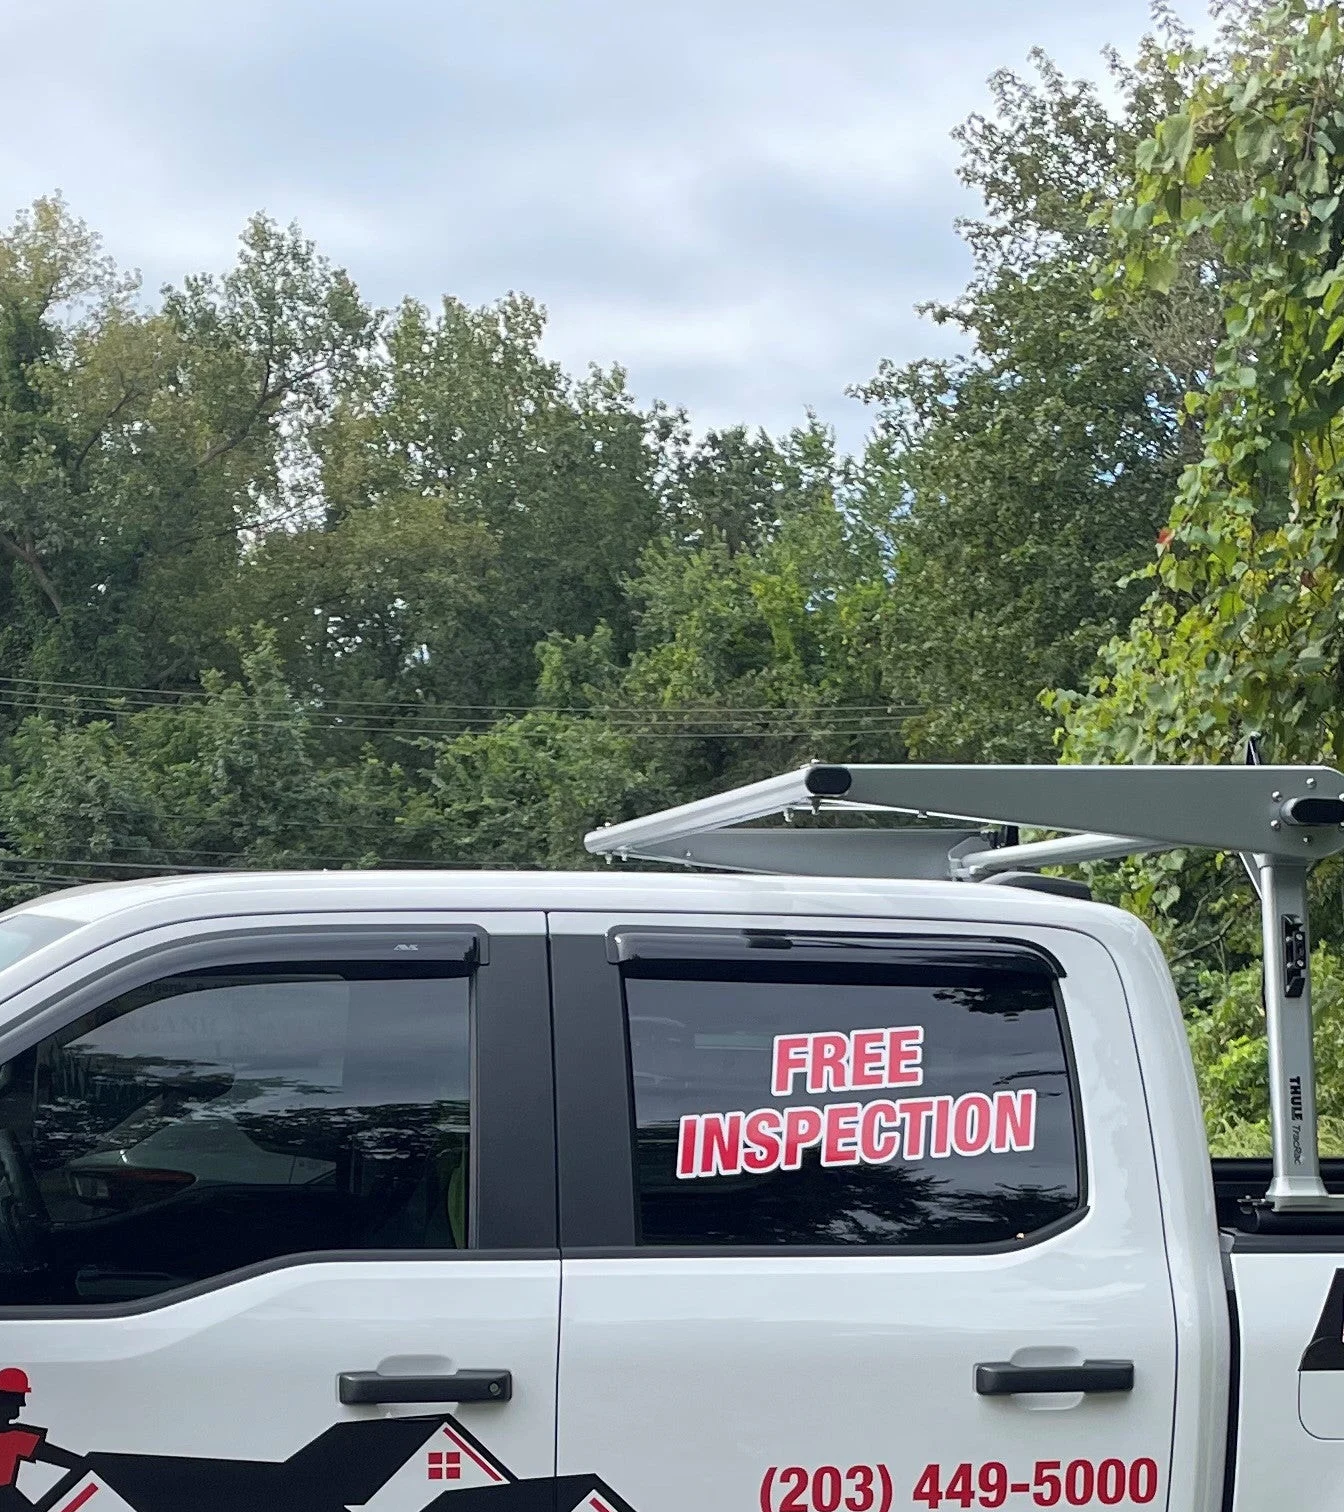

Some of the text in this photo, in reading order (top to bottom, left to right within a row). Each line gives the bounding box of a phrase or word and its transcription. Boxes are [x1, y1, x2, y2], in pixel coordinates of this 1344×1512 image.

[774, 1028, 922, 1094] FREE
[1289, 1076, 1303, 1121] THULE
[677, 1091, 1035, 1177] INSPECTION
[912, 1457, 1158, 1510] 449-5000
